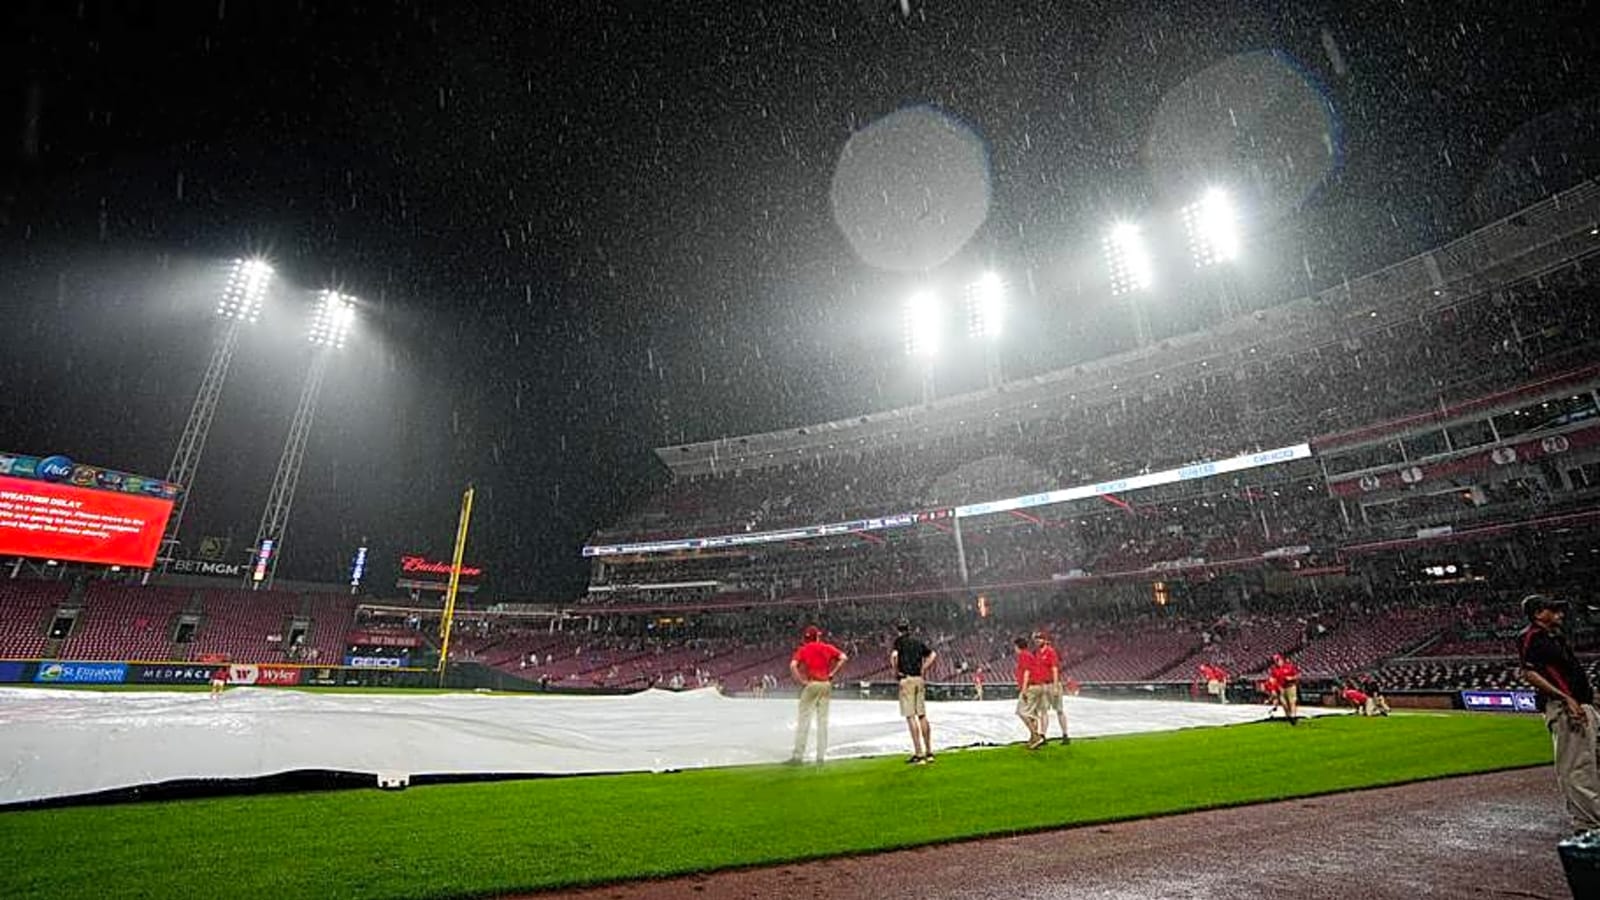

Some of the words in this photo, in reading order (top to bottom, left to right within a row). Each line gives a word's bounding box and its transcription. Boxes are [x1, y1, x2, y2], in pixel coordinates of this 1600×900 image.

[44, 463, 72, 476] P&G
[0, 491, 51, 505] WEATHER
[50, 498, 84, 509] DELAY
[174, 560, 239, 575] BETMGM
[401, 556, 480, 576] Budwser
[351, 656, 401, 668] GEICO
[143, 669, 211, 680] MEDPACE
[262, 669, 297, 683] Wyler
